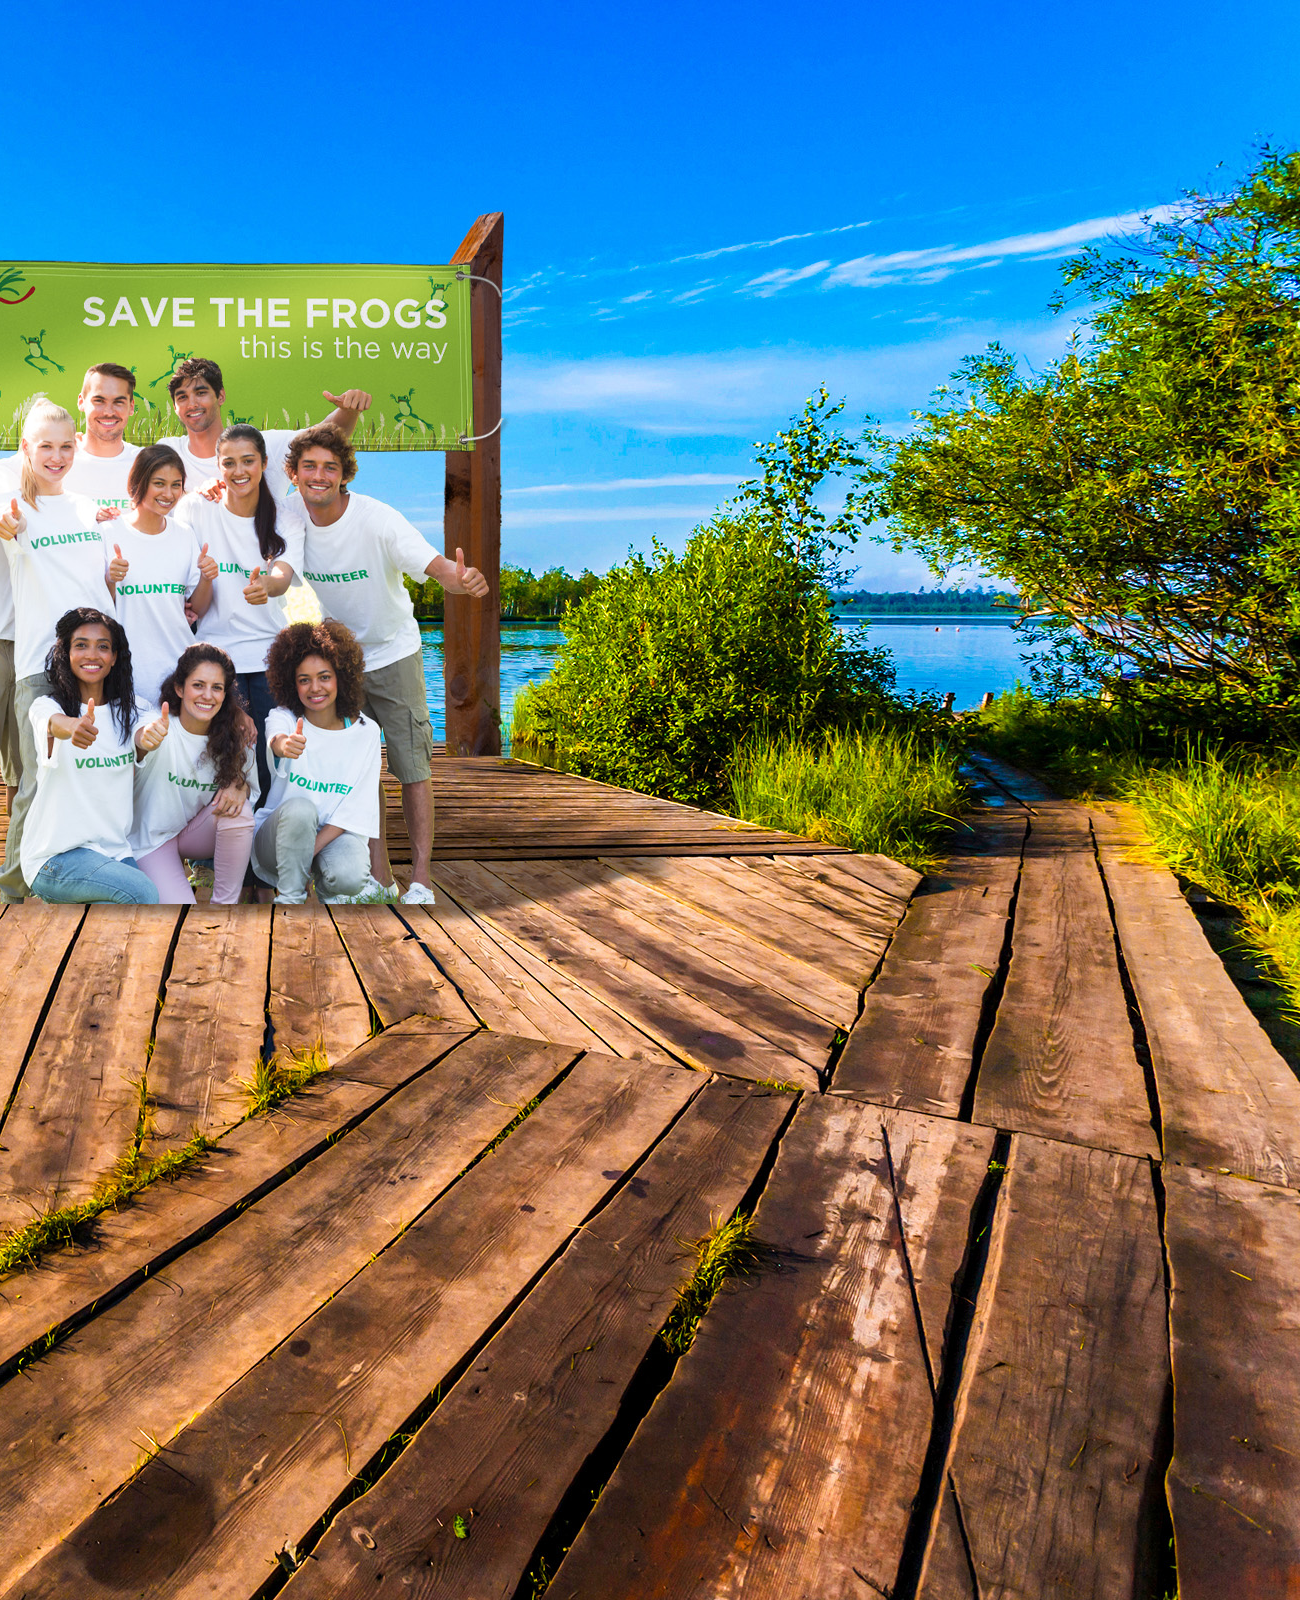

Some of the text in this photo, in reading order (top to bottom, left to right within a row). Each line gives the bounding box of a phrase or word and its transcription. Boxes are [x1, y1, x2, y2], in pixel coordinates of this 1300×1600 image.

[82, 296, 448, 329] SAVE THE FROGS
[239, 334, 448, 364] this is the way
[74, 751, 135, 769] VOLUNTE
